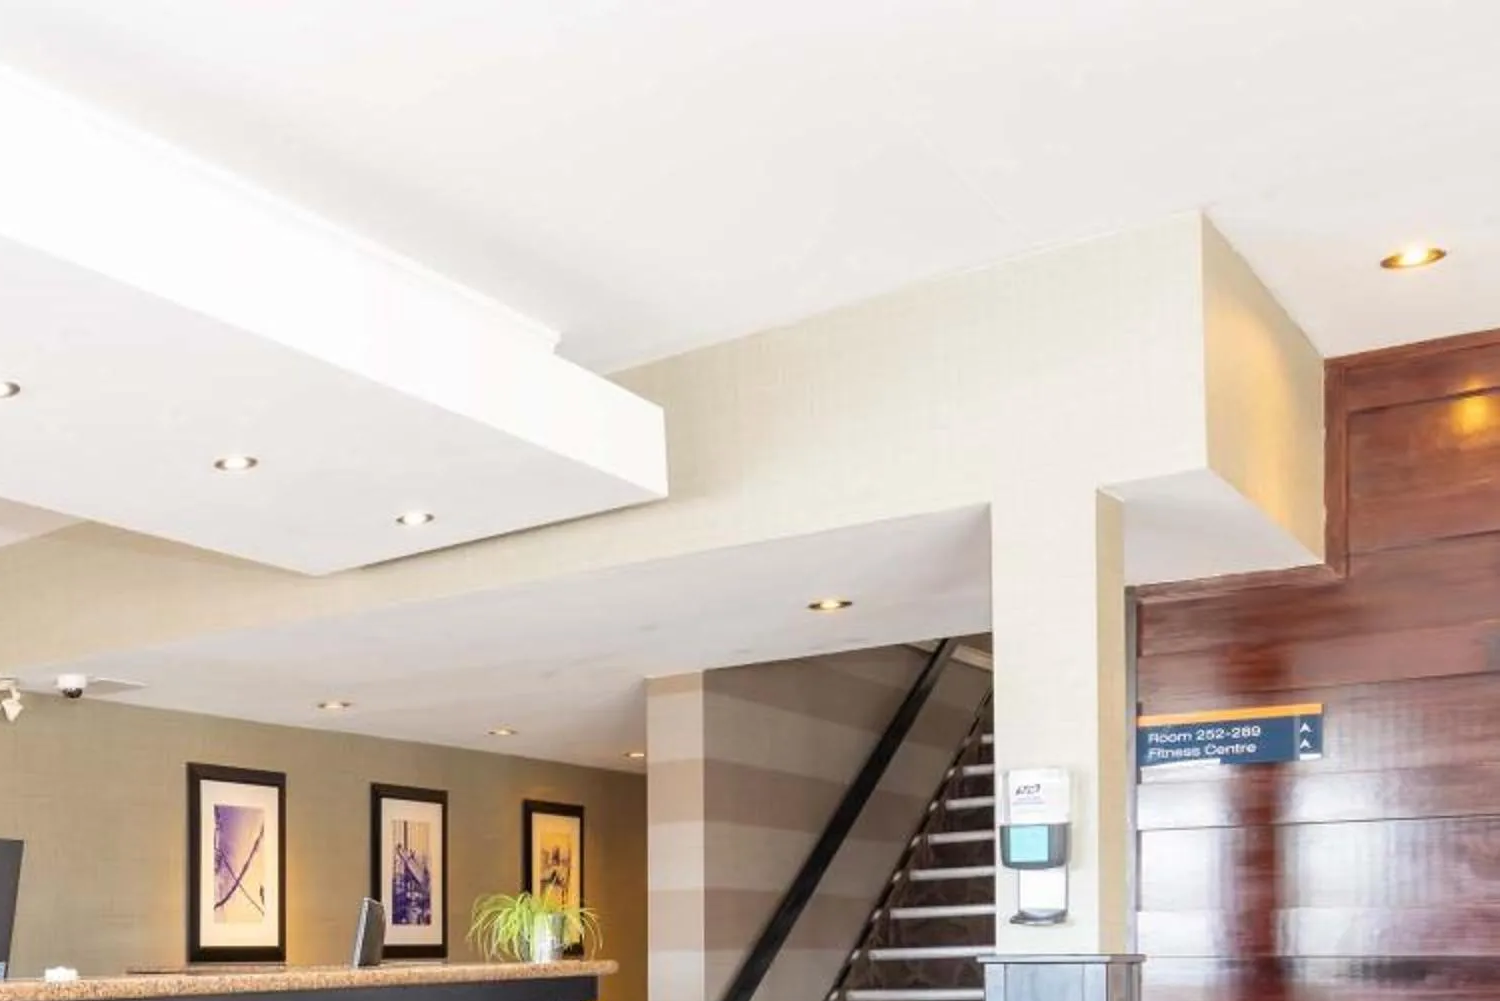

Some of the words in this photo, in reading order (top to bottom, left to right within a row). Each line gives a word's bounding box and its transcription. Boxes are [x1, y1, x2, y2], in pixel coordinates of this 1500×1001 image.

[1147, 732, 1193, 744] Room
[1147, 747, 1201, 761] Fitness
[1205, 743, 1258, 756] Centre
